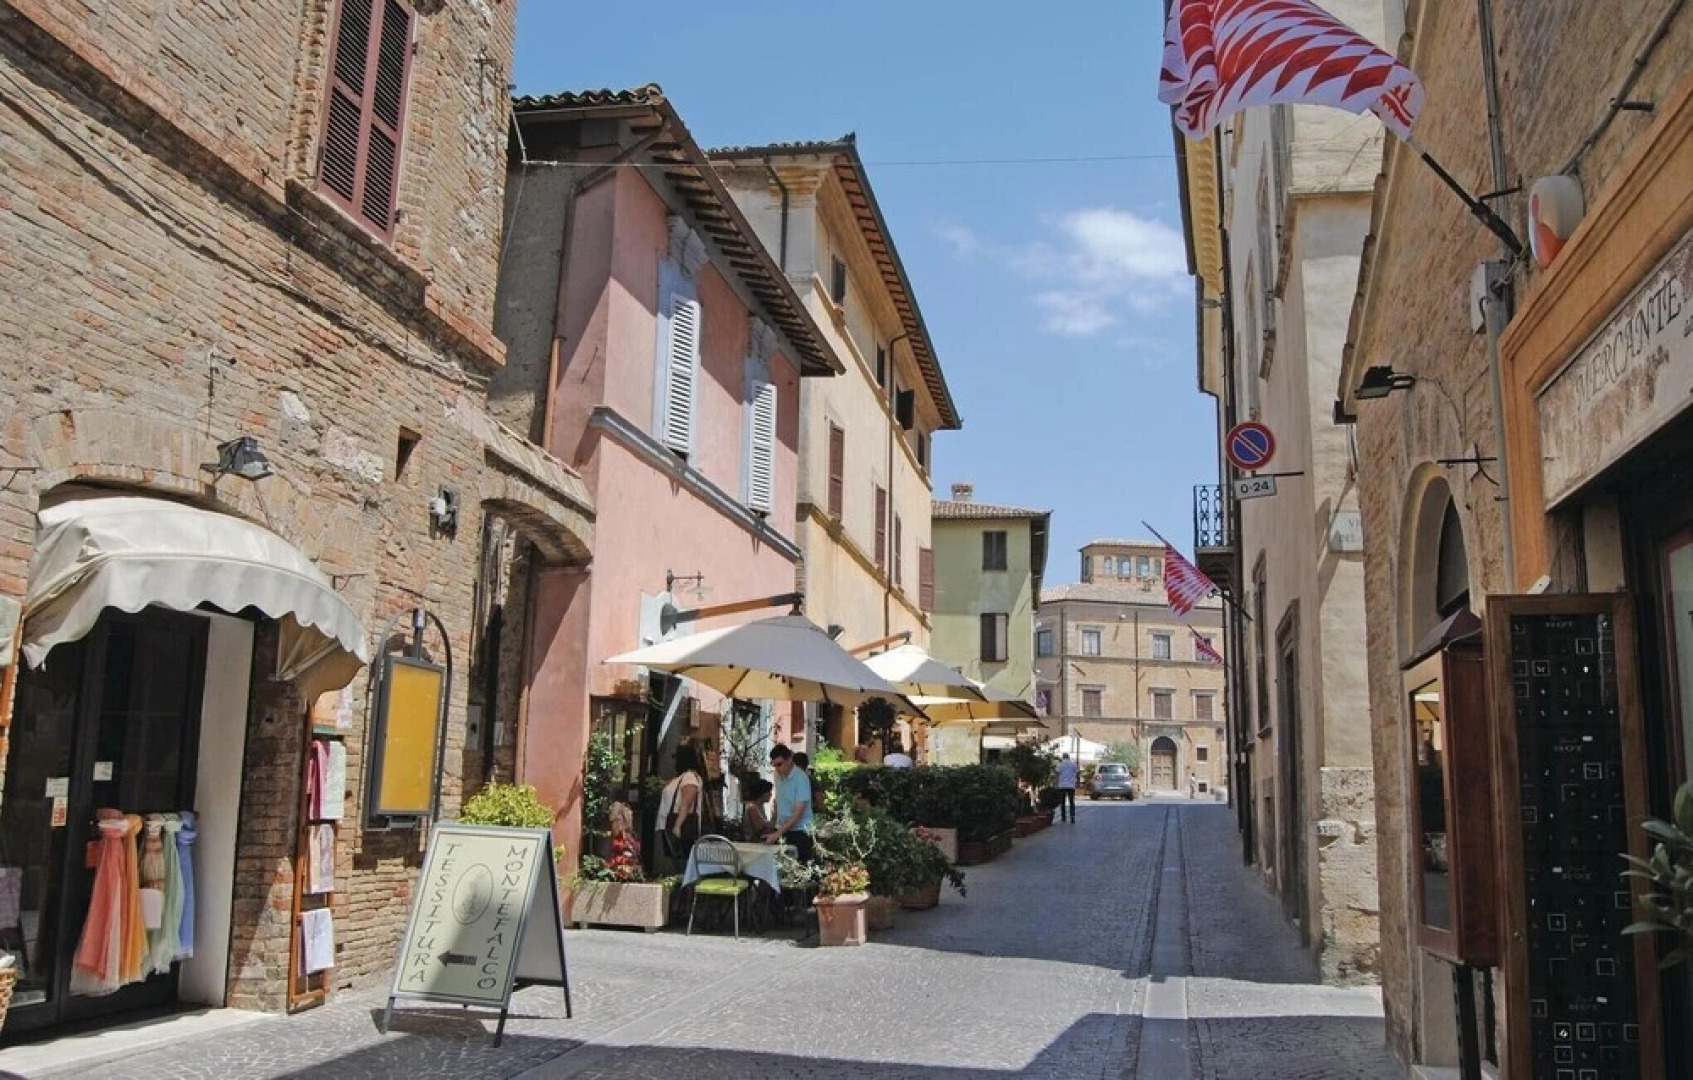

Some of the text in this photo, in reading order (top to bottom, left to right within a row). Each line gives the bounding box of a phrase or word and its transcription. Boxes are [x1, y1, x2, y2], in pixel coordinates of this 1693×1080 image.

[1240, 481, 1269, 494] 0-24
[409, 843, 461, 984] TESSITURA
[477, 845, 527, 990] MONTEFALCO
